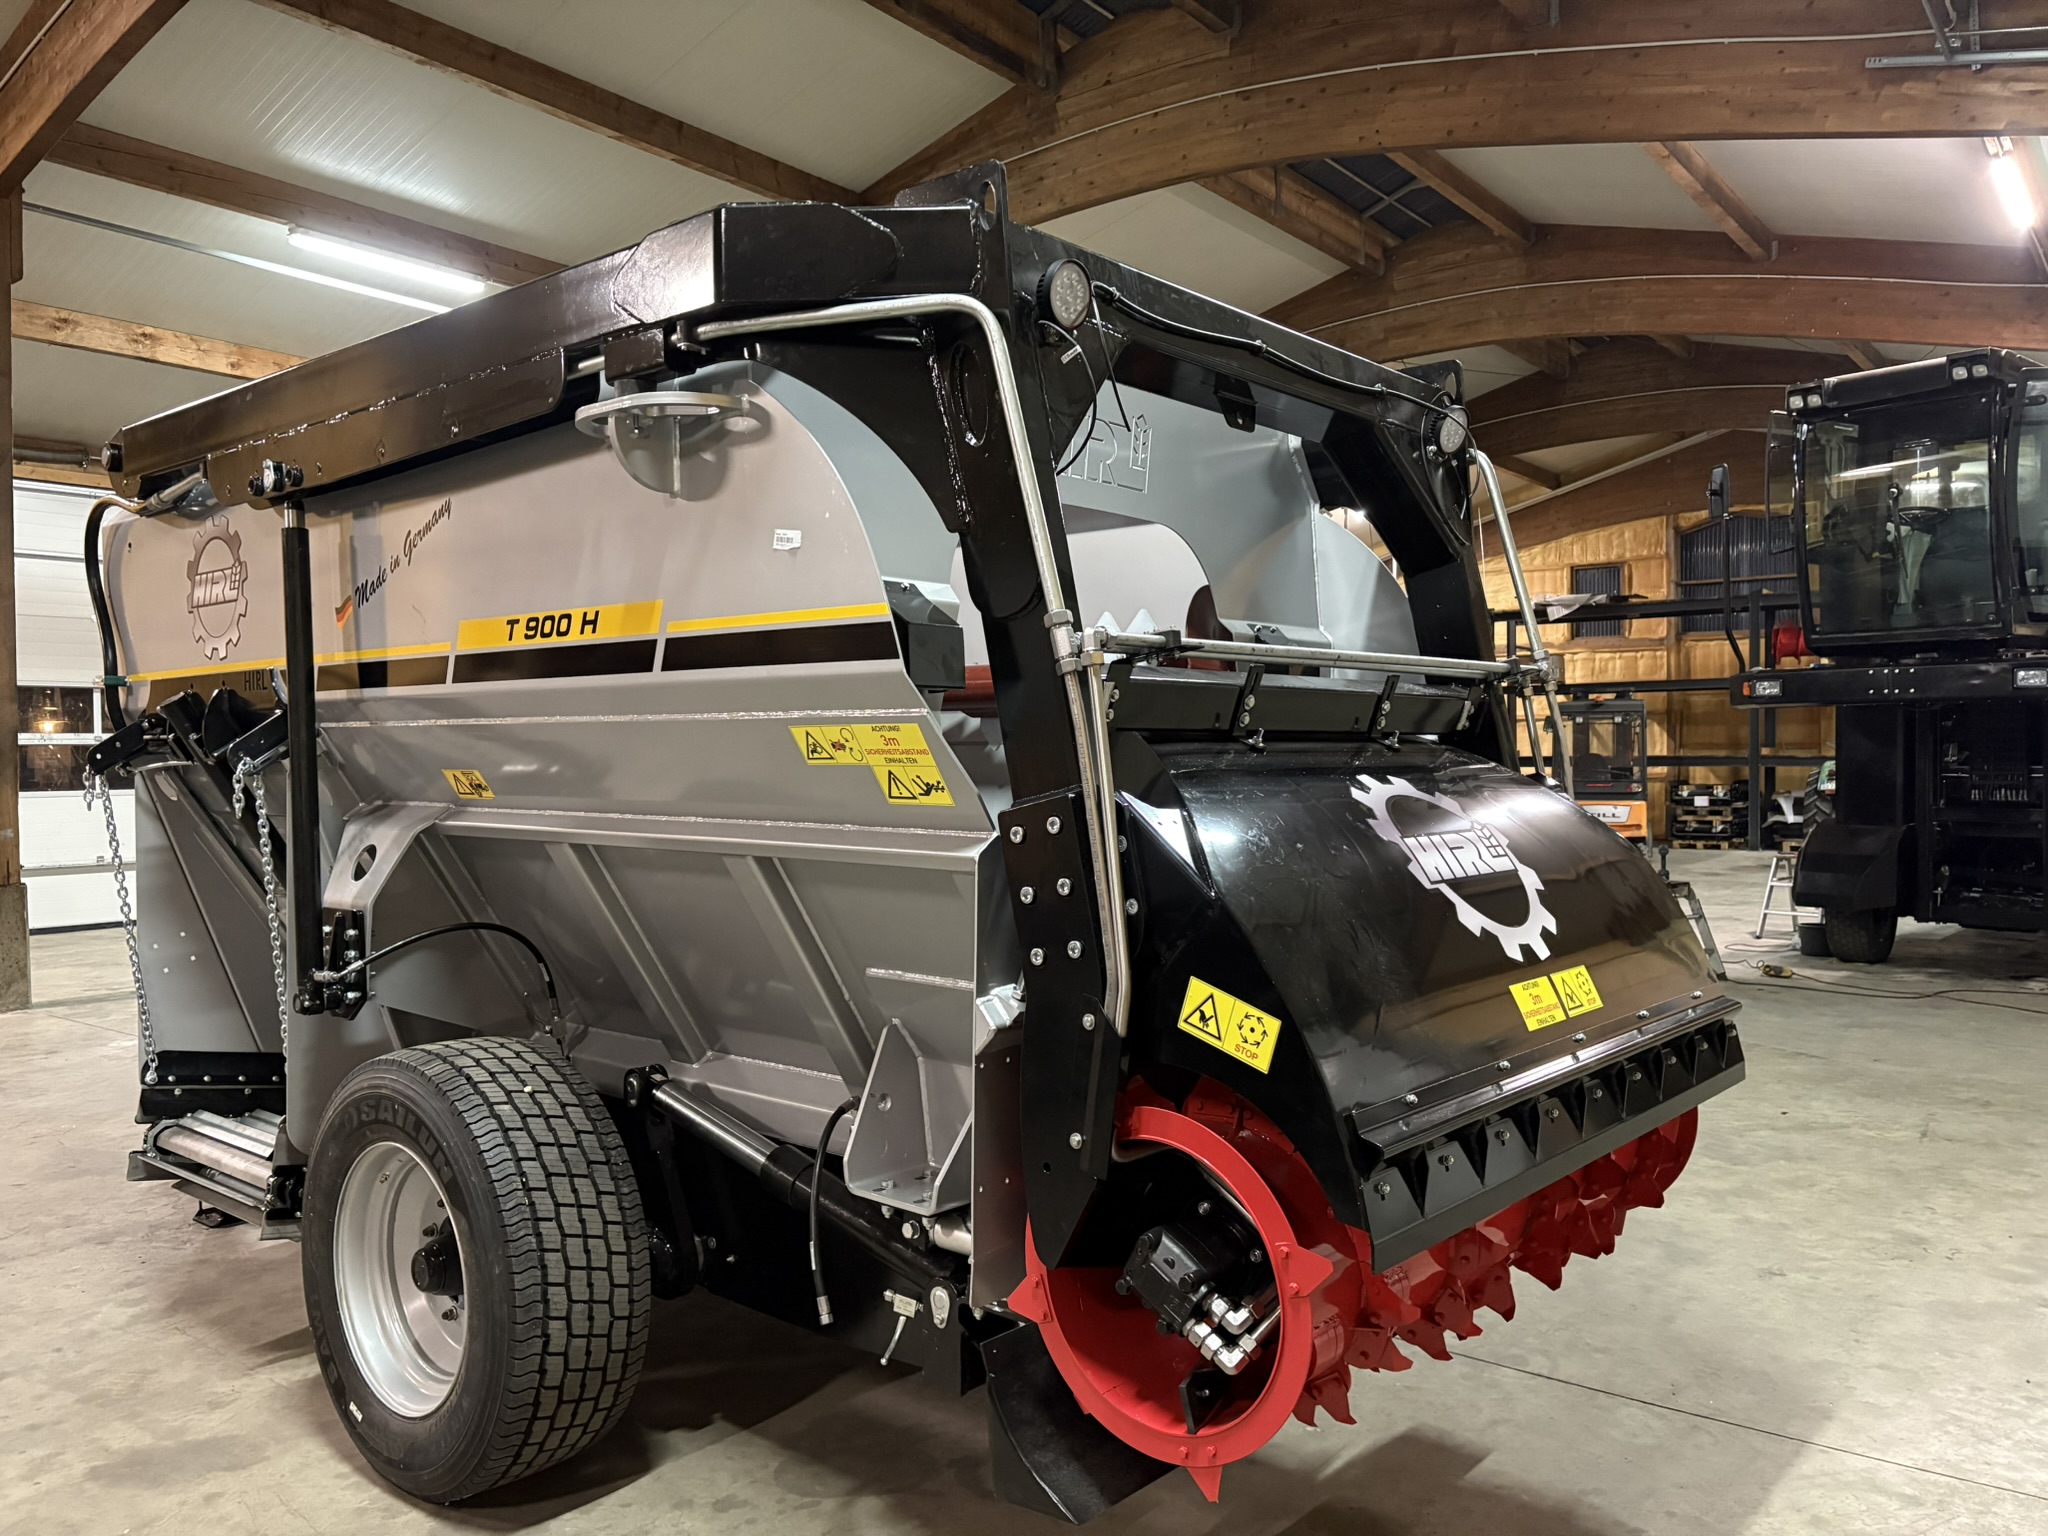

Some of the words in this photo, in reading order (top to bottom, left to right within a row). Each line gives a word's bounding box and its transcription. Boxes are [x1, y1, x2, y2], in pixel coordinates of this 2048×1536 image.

[1060, 413, 1152, 494] IRL
[354, 565, 388, 609] Made
[389, 554, 400, 574] in
[403, 497, 452, 567] Germany
[192, 560, 242, 609] HIRL
[506, 618, 520, 641] T
[524, 613, 572, 640] 900
[580, 610, 599, 635] H
[242, 670, 268, 691] HIRL
[880, 734, 900, 747] 3m
[1402, 824, 1518, 884] HIRL
[1234, 1043, 1259, 1061] STOP
[360, 1099, 454, 1184] SAILUN
